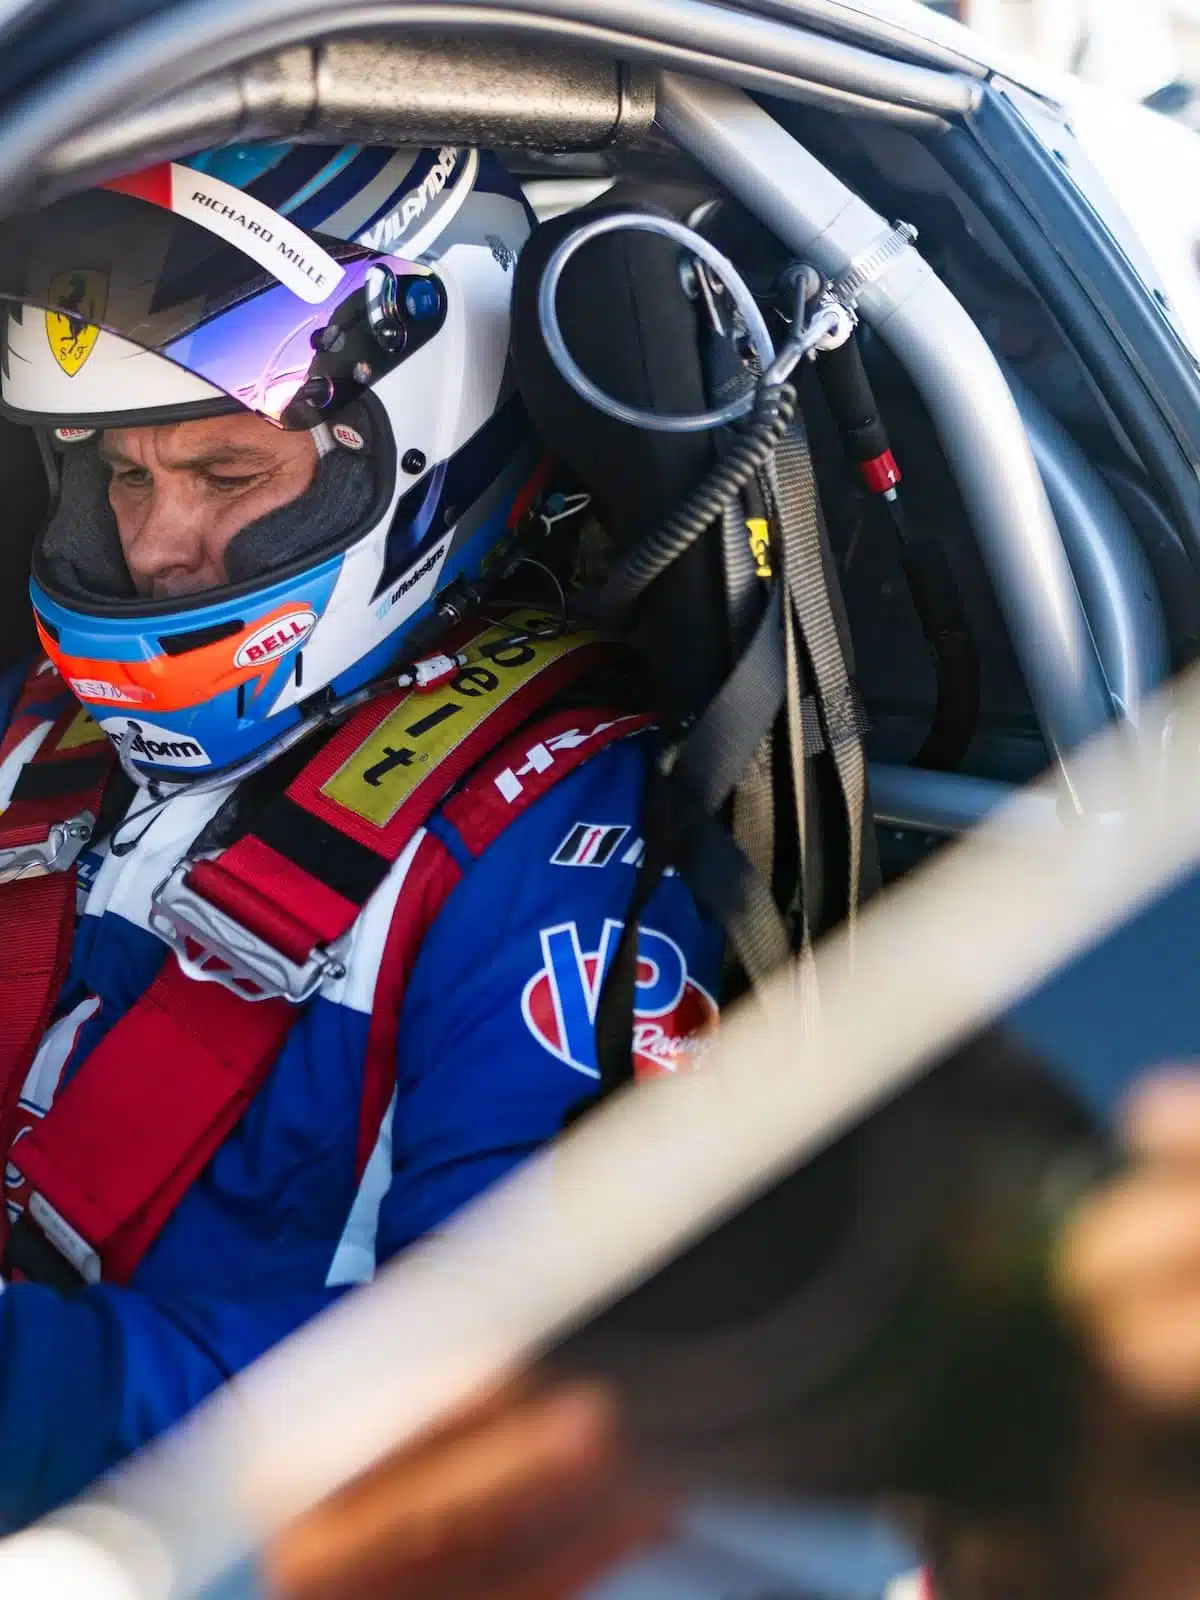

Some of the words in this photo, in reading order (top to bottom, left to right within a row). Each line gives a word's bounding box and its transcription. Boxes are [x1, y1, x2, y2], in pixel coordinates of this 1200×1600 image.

[192, 191, 274, 243] RICHARD
[277, 242, 327, 288] MILLE
[336, 429, 361, 444] BELL
[245, 621, 307, 661] BELL
